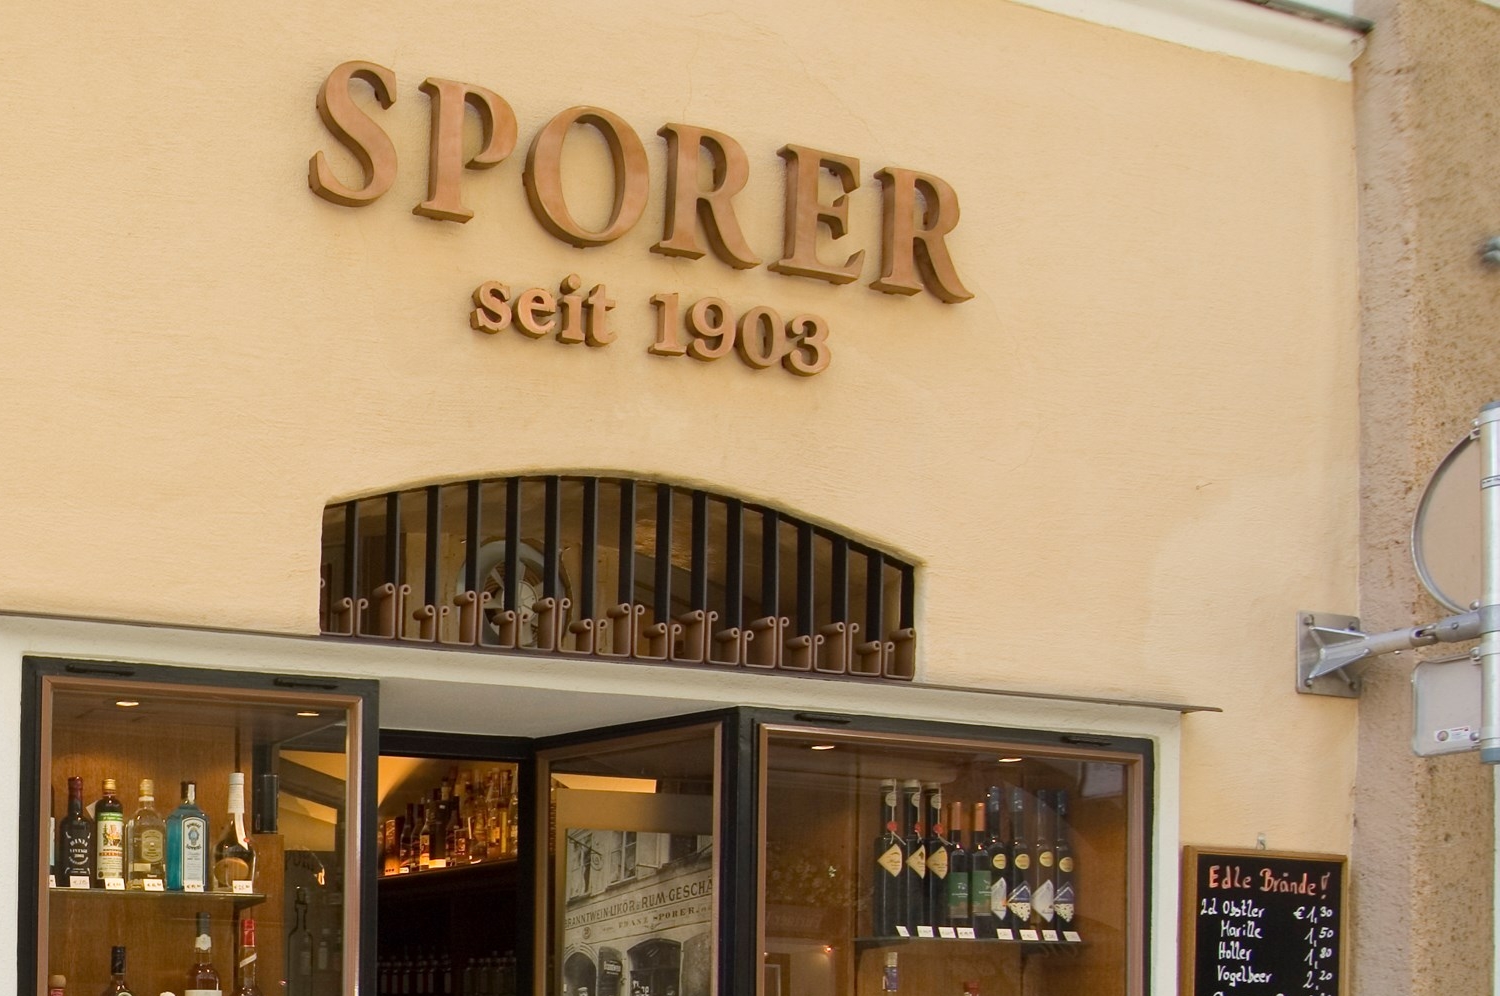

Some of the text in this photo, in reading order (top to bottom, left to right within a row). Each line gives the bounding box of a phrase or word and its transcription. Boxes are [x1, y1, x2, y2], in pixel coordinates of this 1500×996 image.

[308, 60, 975, 304] SPORER
[470, 273, 831, 377] seit 1903
[1209, 865, 1251, 889] Edle
[1222, 899, 1265, 918] Obstler
[1220, 920, 1263, 939] Marille
[1219, 941, 1252, 961] Holler
[1217, 965, 1273, 987] Vogelbeer
